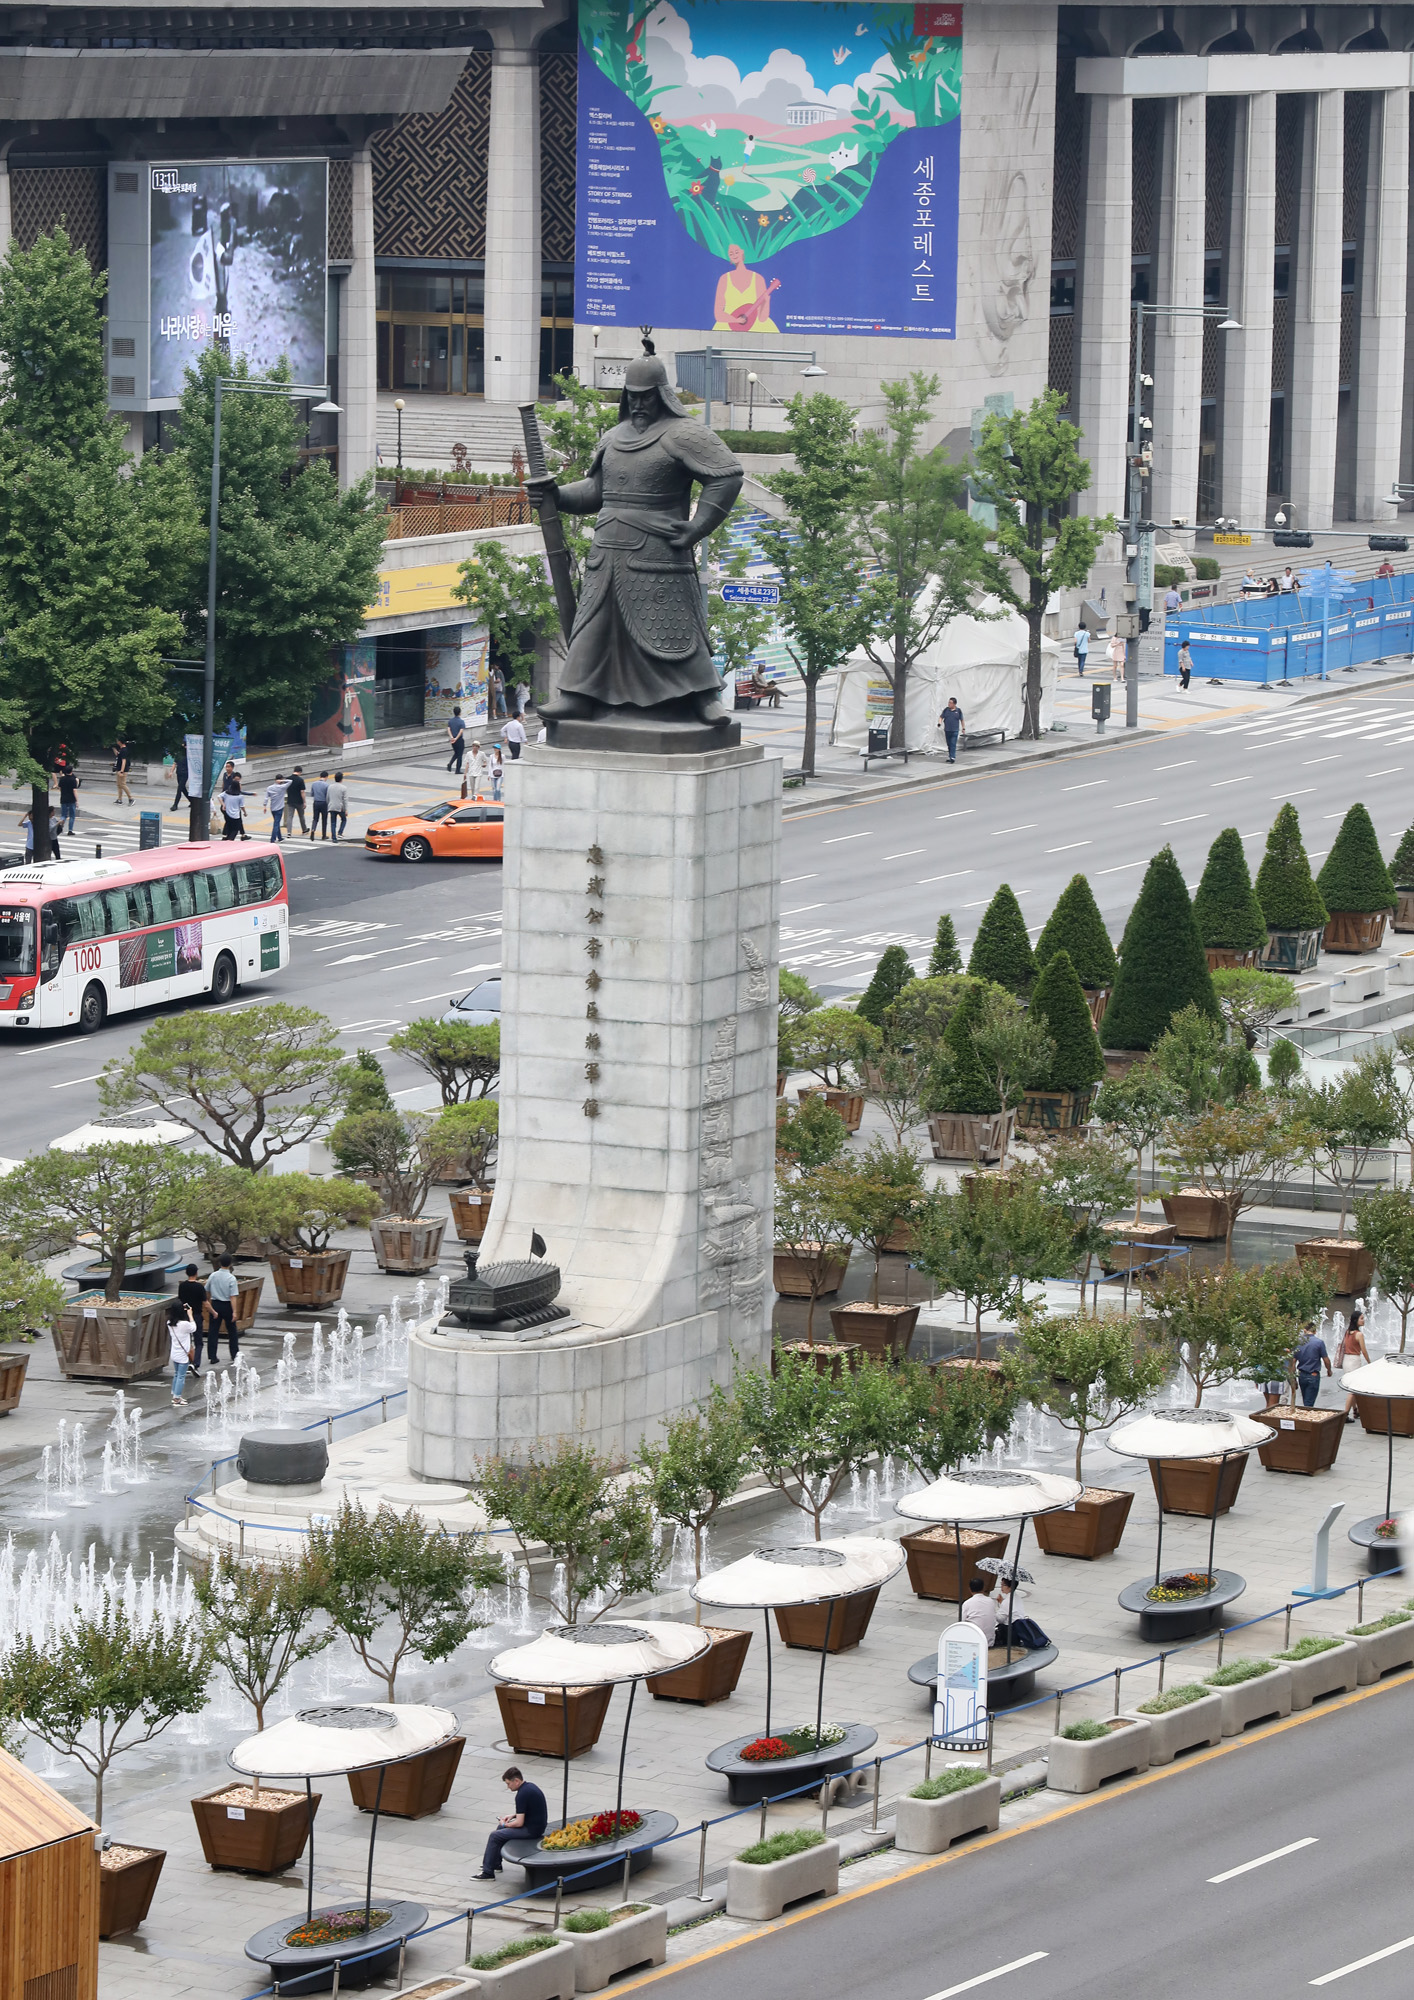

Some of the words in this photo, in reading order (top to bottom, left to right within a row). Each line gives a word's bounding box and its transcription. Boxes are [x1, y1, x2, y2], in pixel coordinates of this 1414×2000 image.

[155, 172, 175, 187] 13:11
[912, 156, 936, 301] 세종포레스트
[160, 314, 212, 341] 나라사랑하는
[213, 312, 238, 338] 마음은
[737, 587, 776, 596] 세종대로23길
[13, 912, 31, 922] 서울역
[74, 946, 101, 973] 1000
